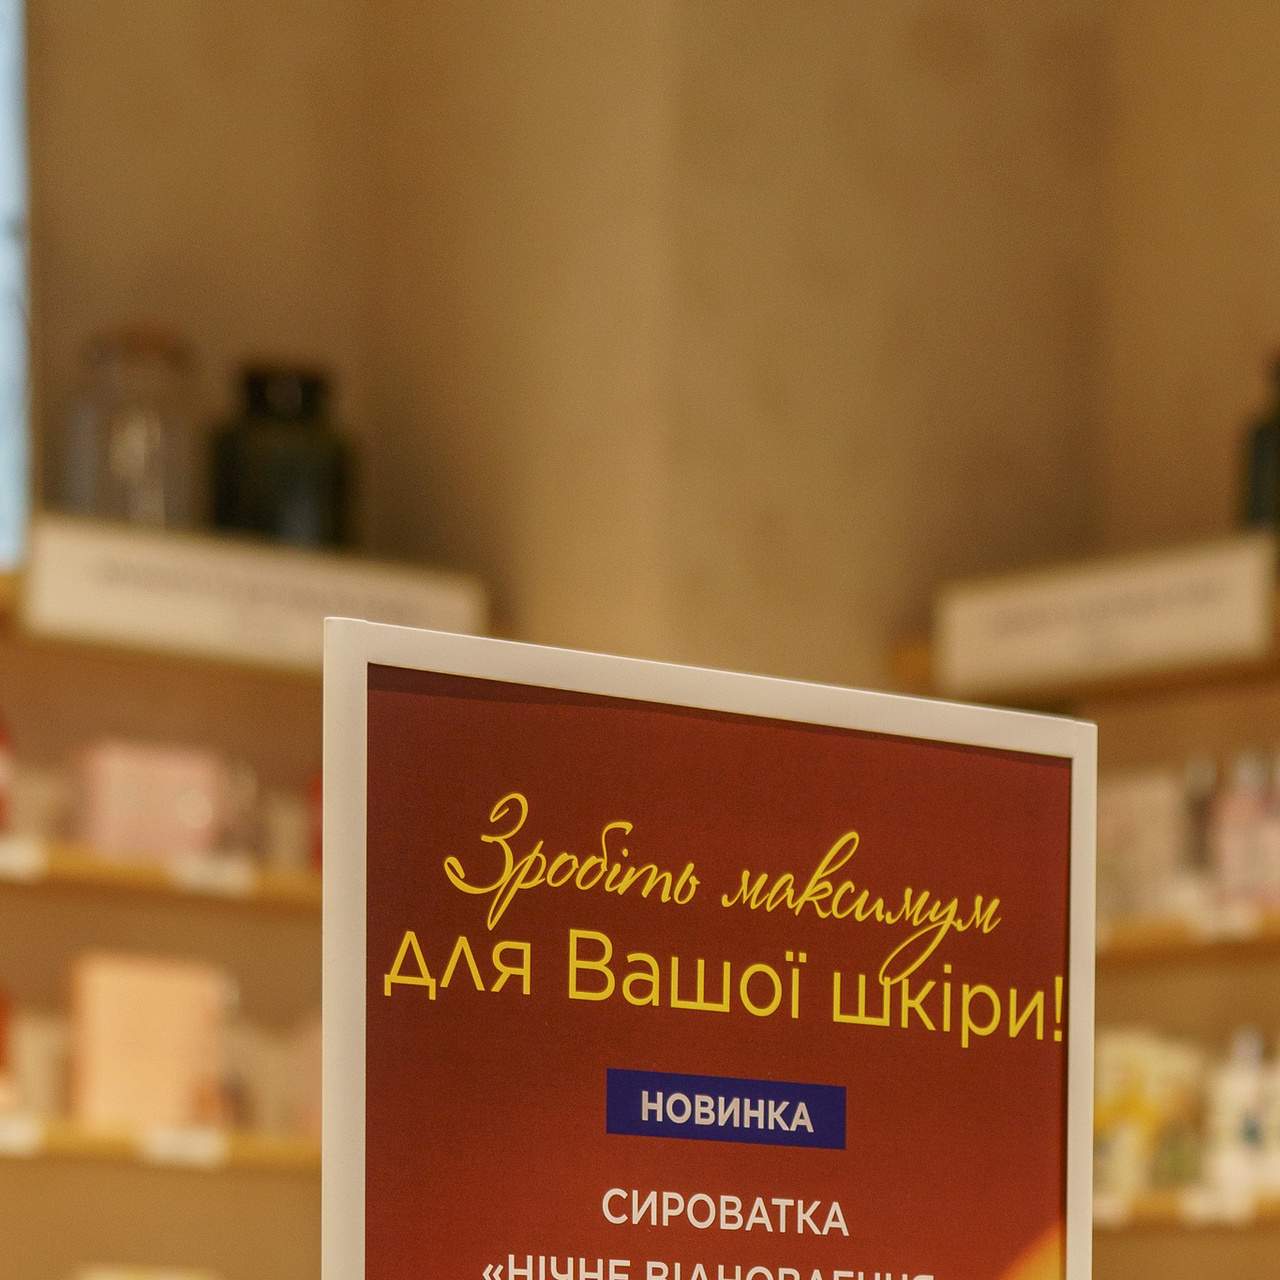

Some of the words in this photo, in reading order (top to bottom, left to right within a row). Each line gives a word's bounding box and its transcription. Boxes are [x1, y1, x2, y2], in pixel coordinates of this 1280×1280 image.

[444, 793, 701, 930] Зробіть
[721, 831, 1001, 988] максимум
[384, 930, 532, 1001] для
[567, 929, 807, 1020] Вашої
[833, 964, 1064, 1048] шкіри!
[641, 1091, 814, 1134] НОВИНКА
[601, 1188, 850, 1237] СИРОВАТКА
